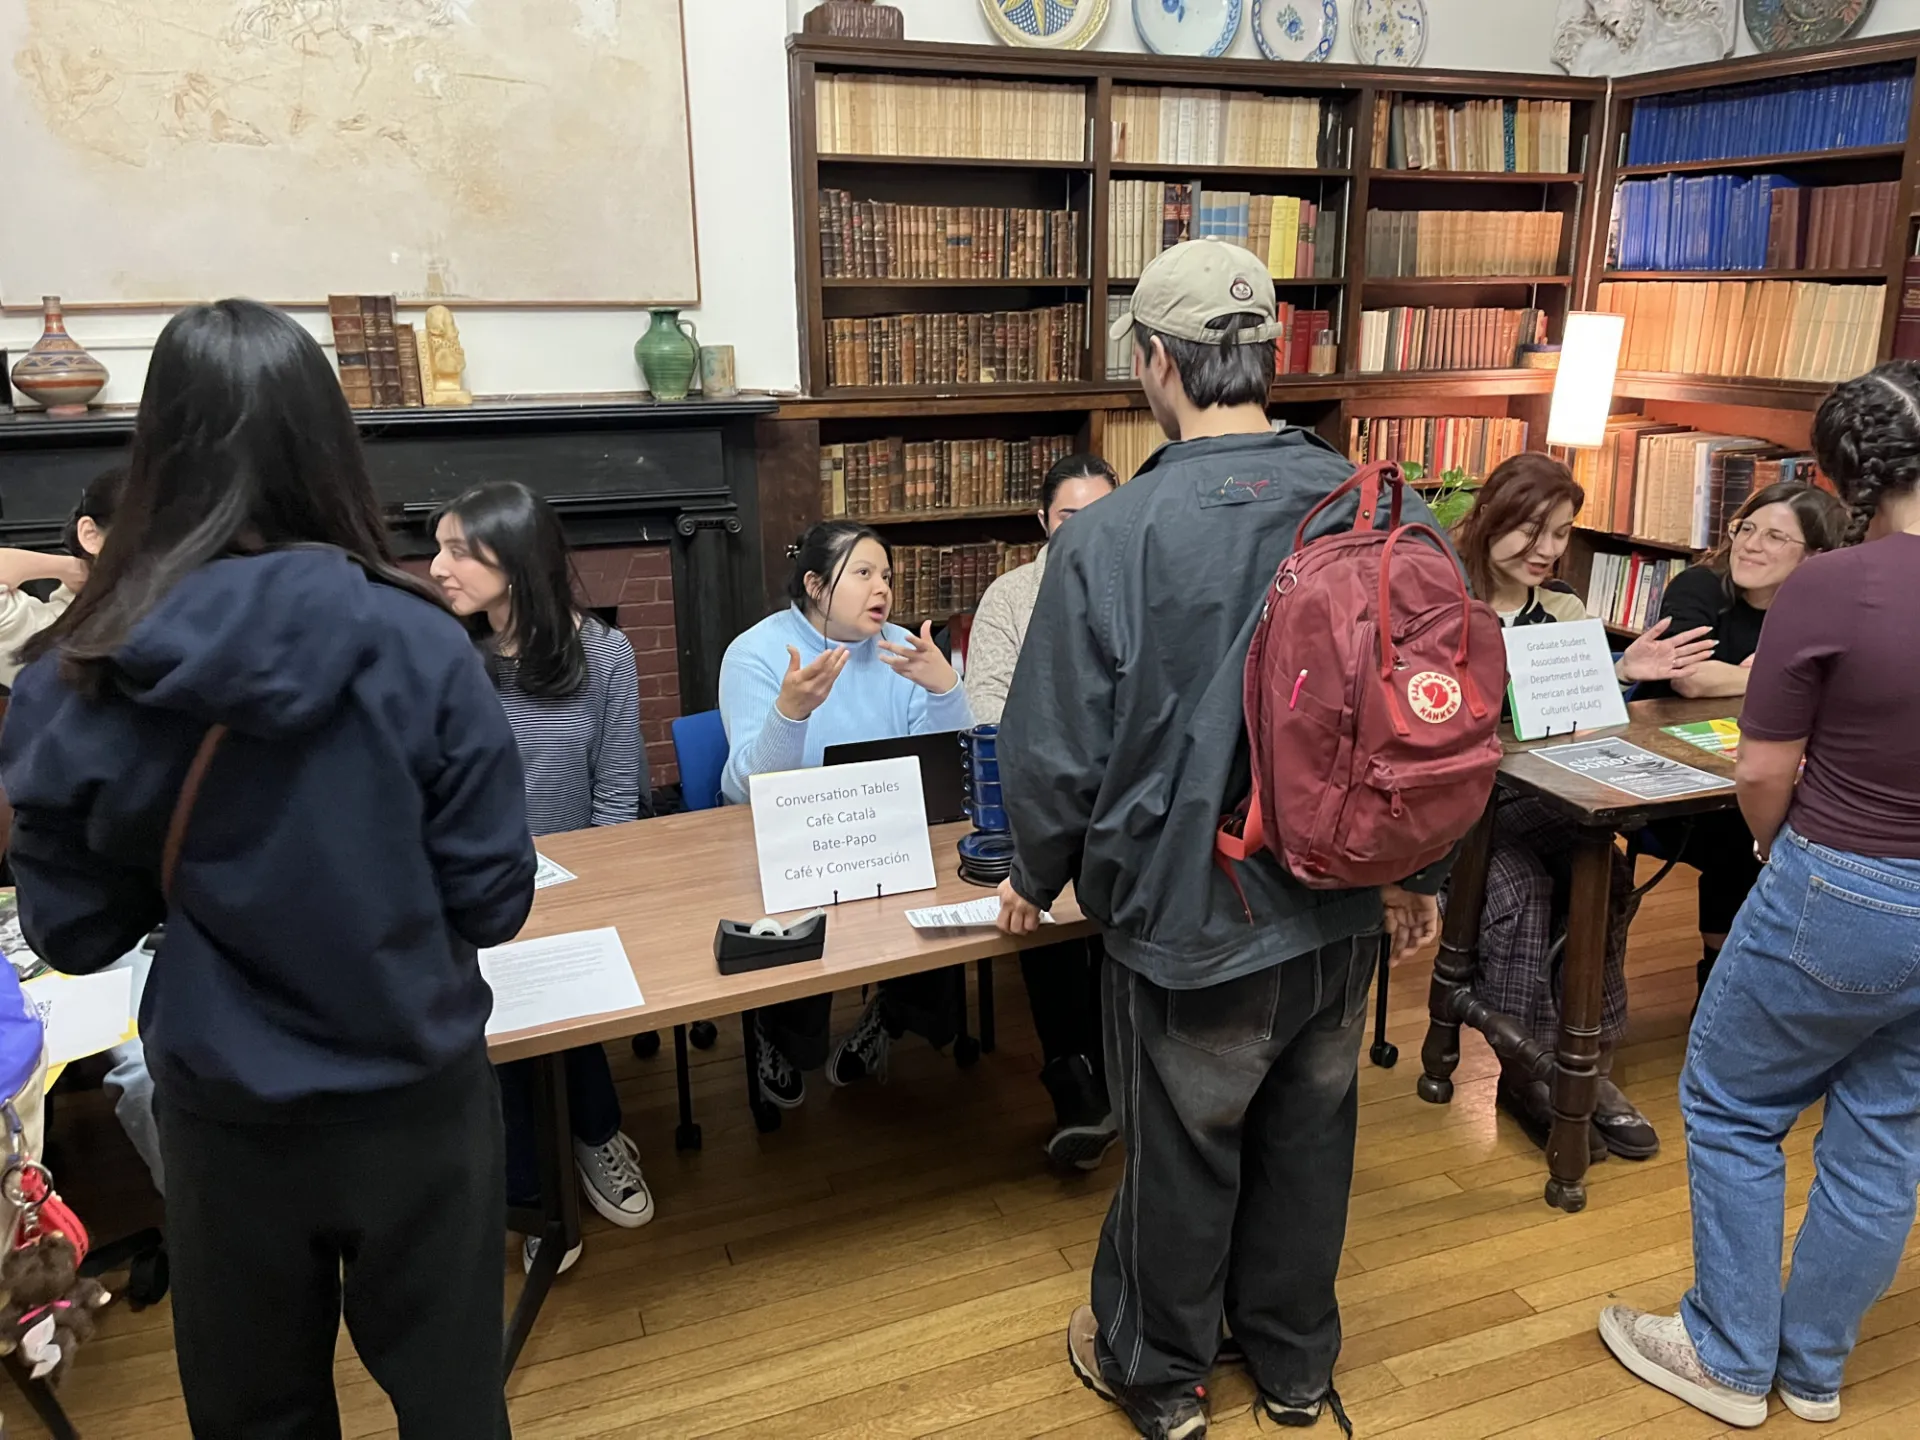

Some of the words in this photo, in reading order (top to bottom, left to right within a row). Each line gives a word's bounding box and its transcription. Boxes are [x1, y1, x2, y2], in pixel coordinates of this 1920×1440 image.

[1527, 641, 1559, 652] Graduate
[1560, 637, 1586, 648] Student
[1531, 656, 1570, 667] Association
[1571, 654, 1578, 663] of
[1579, 652, 1591, 661] the
[1530, 671, 1572, 684] Department
[1573, 669, 1580, 678] of
[1582, 667, 1598, 677] Latin
[1531, 689, 1564, 701] American
[1566, 686, 1579, 696] and
[1580, 683, 1604, 694] Iberian
[1541, 705, 1570, 716] Cultures
[1571, 699, 1602, 713] (GALAIC)
[1569, 754, 1654, 771] Sonoros
[775, 787, 858, 808] Conversation
[861, 780, 900, 796] Tables
[837, 807, 877, 823] Català
[812, 833, 877, 852] Bate-Papo
[784, 865, 813, 881] Café
[816, 866, 824, 879] y
[826, 851, 910, 875] Conversación
